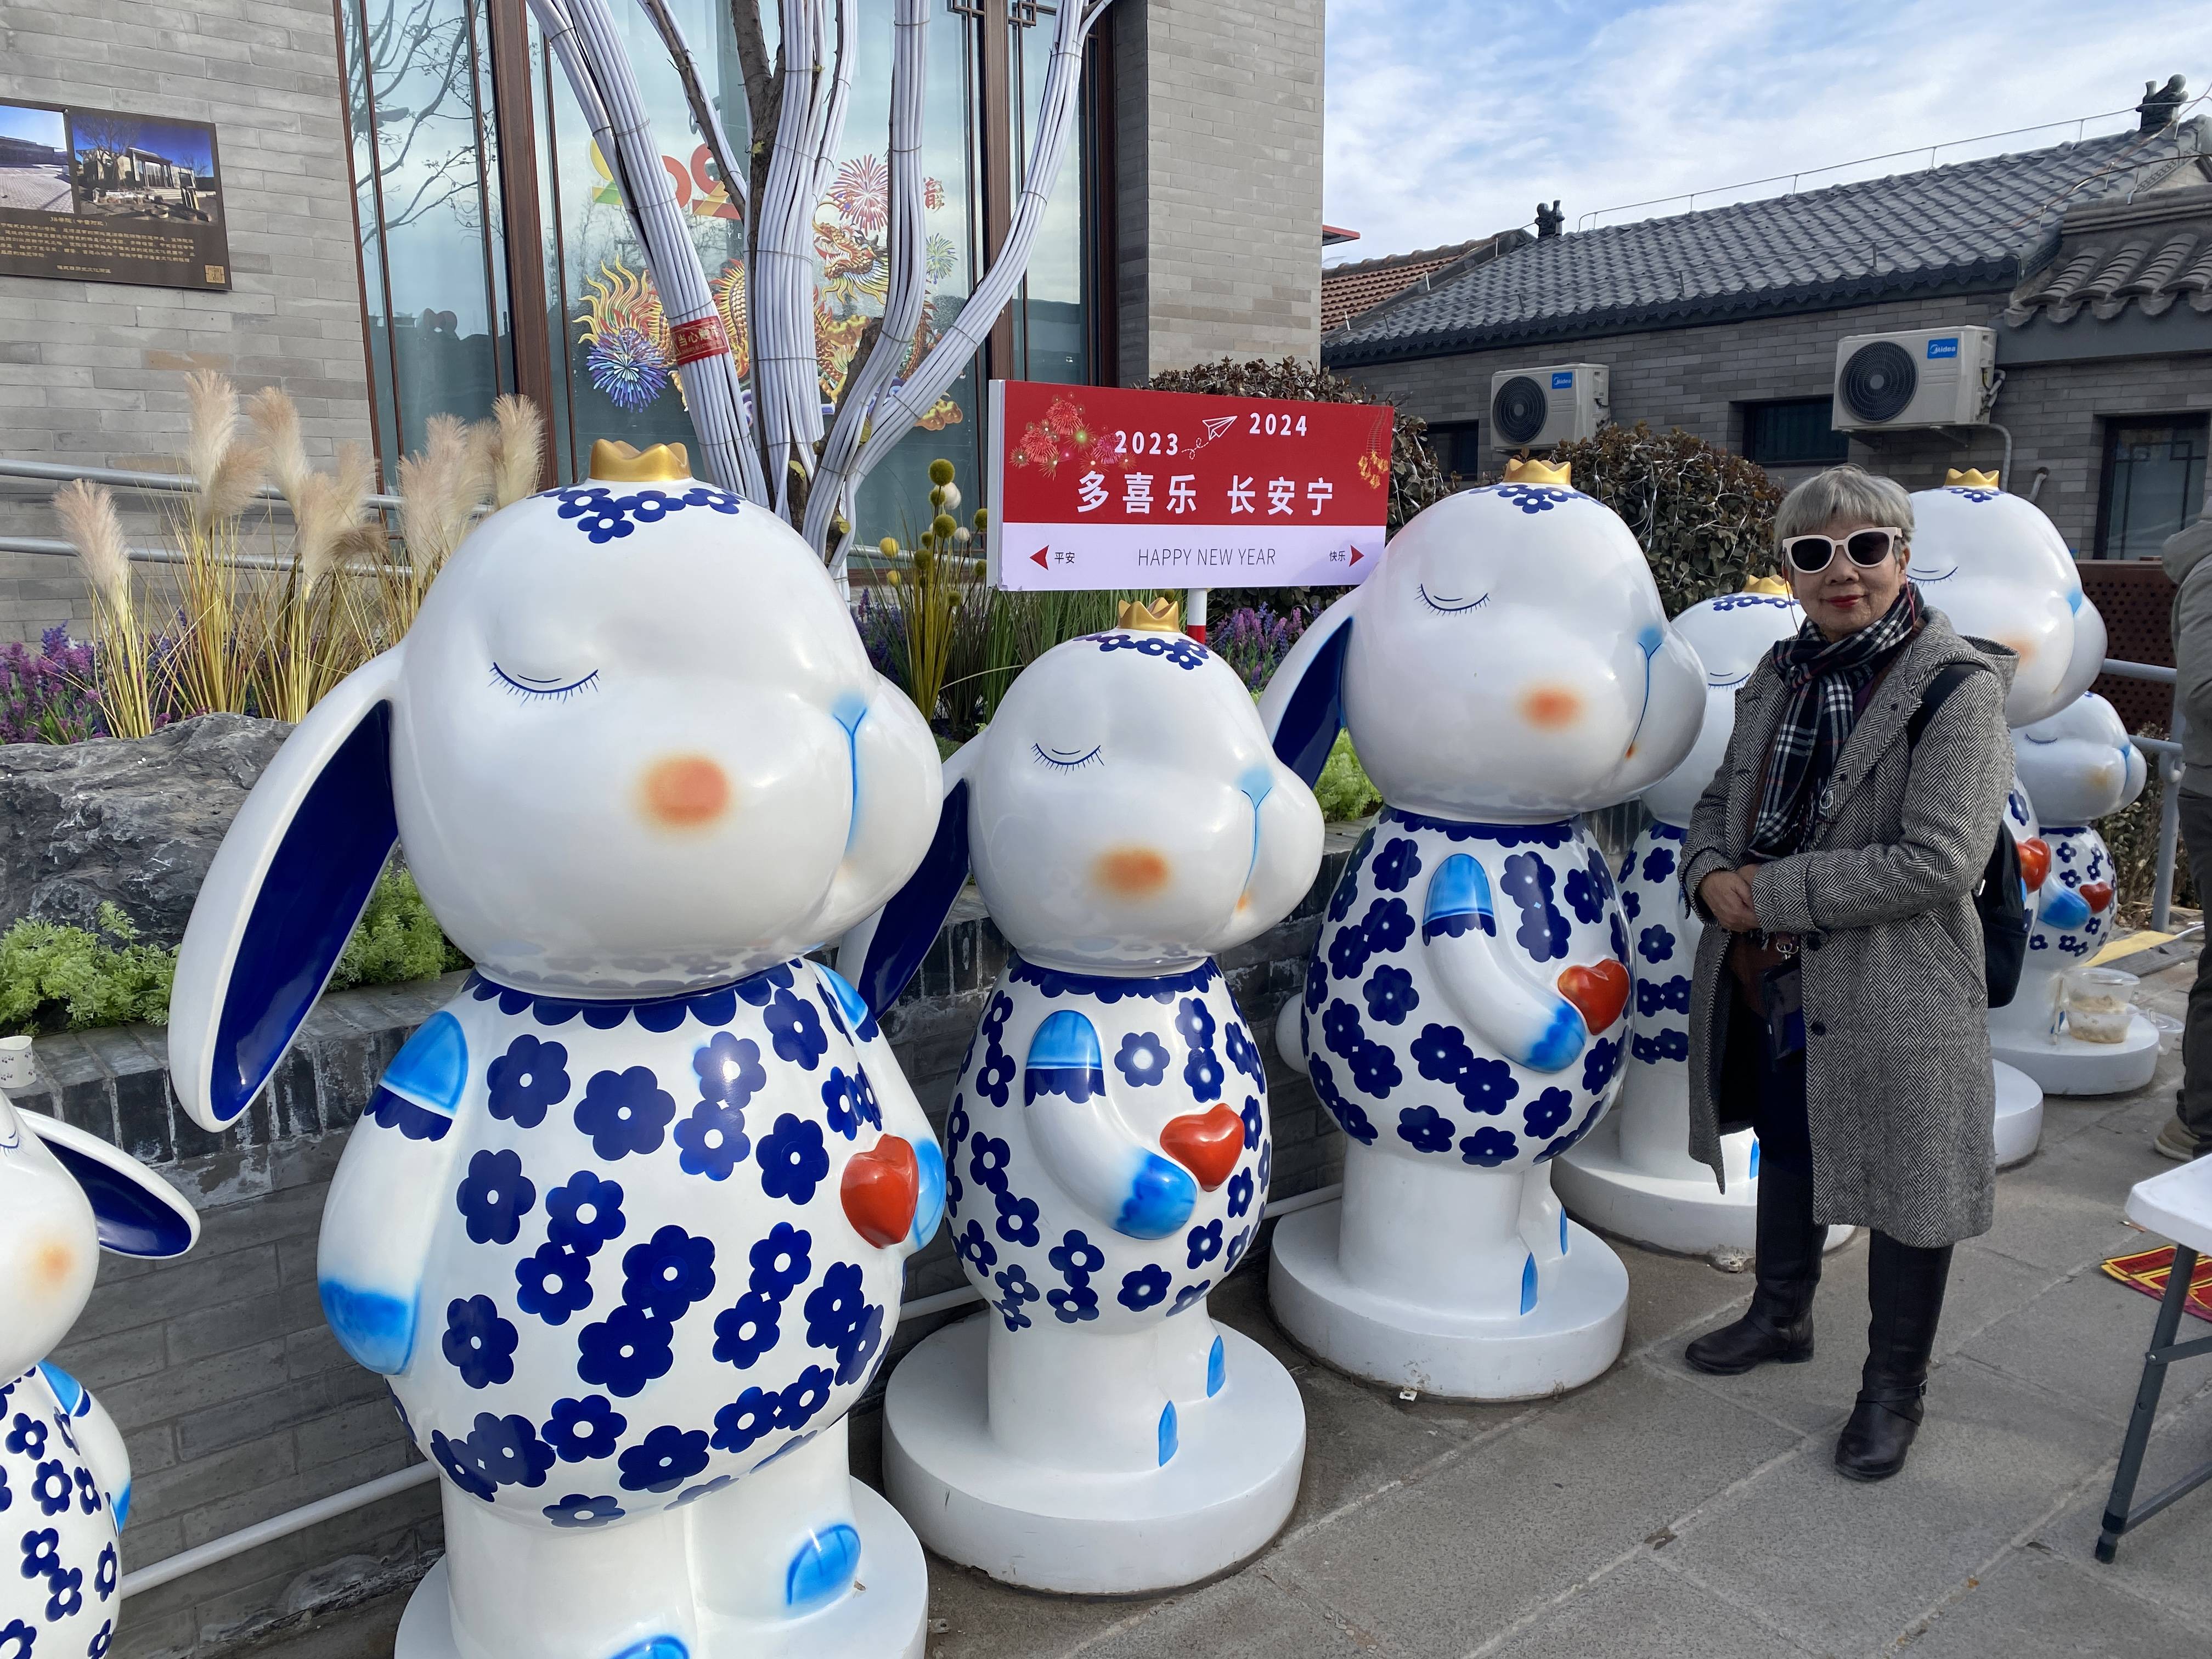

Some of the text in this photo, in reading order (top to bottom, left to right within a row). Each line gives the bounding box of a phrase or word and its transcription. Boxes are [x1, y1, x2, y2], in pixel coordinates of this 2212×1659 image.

[1931, 345, 1956, 354] Midea
[1554, 377, 1571, 385] Midea
[1249, 412, 1307, 436] 2024
[1114, 430, 1178, 455] 2023
[1077, 470, 1333, 516] 多喜乐 长安宁
[1054, 551, 1075, 564] 平安
[1138, 549, 1276, 566] HAPPY NEW YEAR
[1329, 550, 1346, 562] 快乐
